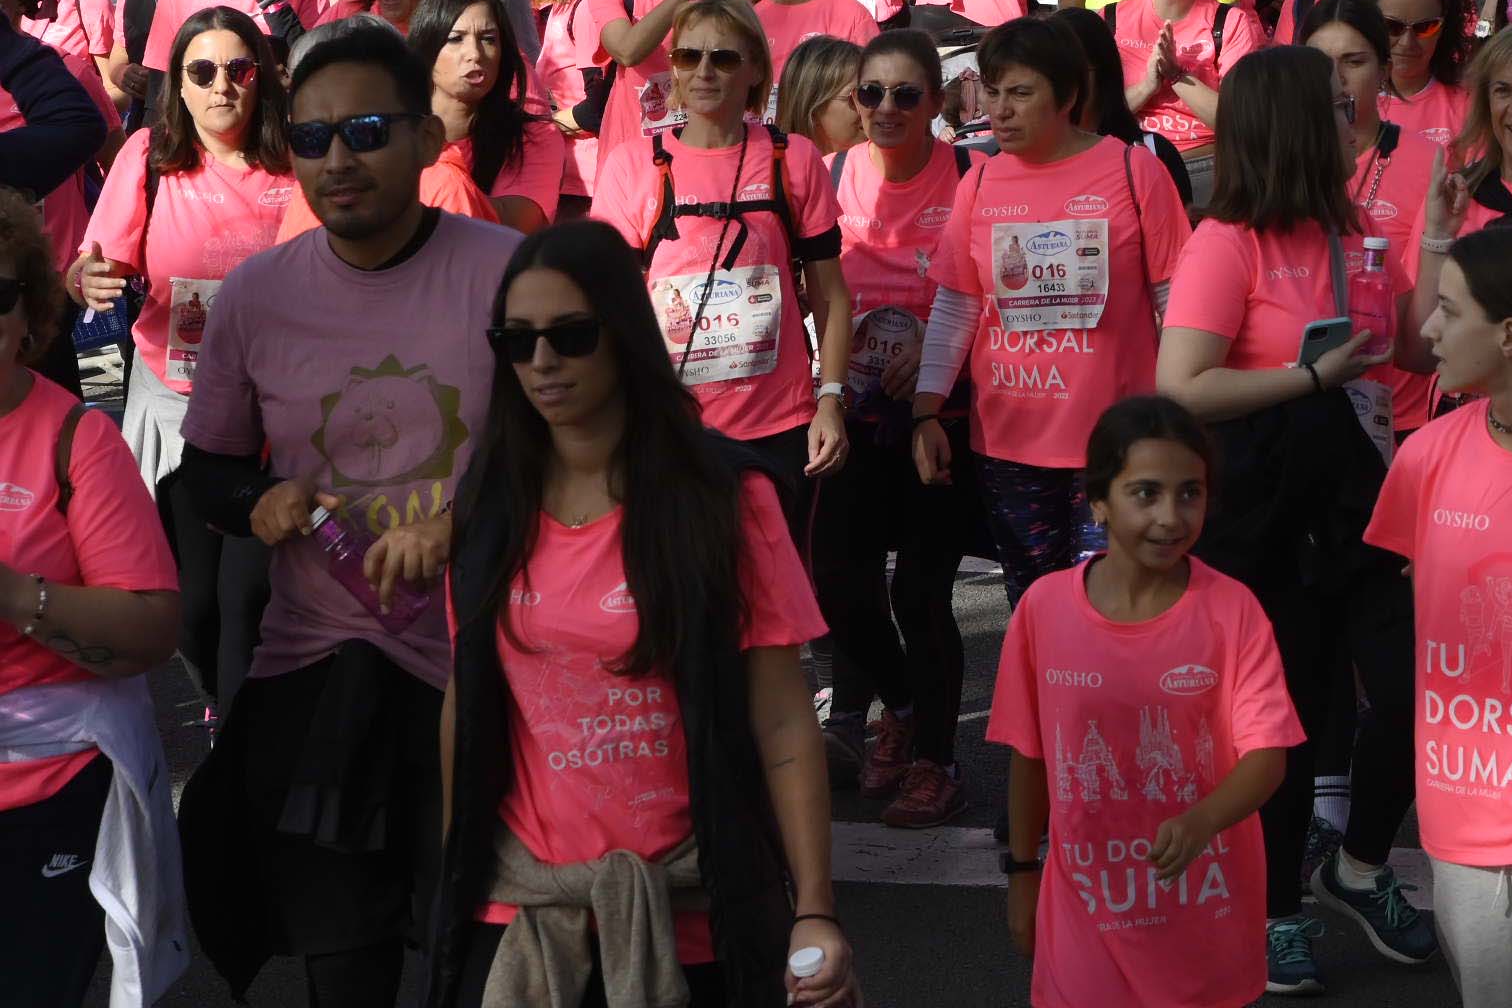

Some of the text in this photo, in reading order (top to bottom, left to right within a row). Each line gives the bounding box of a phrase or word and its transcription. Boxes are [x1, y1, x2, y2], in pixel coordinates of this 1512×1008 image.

[647, 194, 698, 211] OHO
[981, 203, 1029, 217] OYSHO
[1031, 263, 1067, 280] 016
[693, 288, 740, 304] ATURIANA
[1037, 282, 1066, 294] 16433
[1008, 297, 1039, 307] CARRERA
[1040, 297, 1051, 305] DE
[1051, 297, 1061, 305] LA
[698, 312, 740, 332] 016
[1006, 311, 1042, 324] OYSHO
[703, 332, 737, 347] 33056
[867, 335, 904, 357] 016
[989, 325, 1095, 354] DORSAL
[682, 366, 710, 378] YSHO
[991, 361, 1066, 391] SUMA
[1433, 507, 1491, 532] OYSHO
[1425, 639, 1465, 678] TU
[1046, 667, 1104, 689] OYSHO
[607, 687, 662, 707] POR
[577, 712, 667, 736] TODAS
[1061, 833, 1231, 868] TU DOAL
[48, 853, 79, 869] NIKE
[1072, 861, 1231, 915] SUMA
